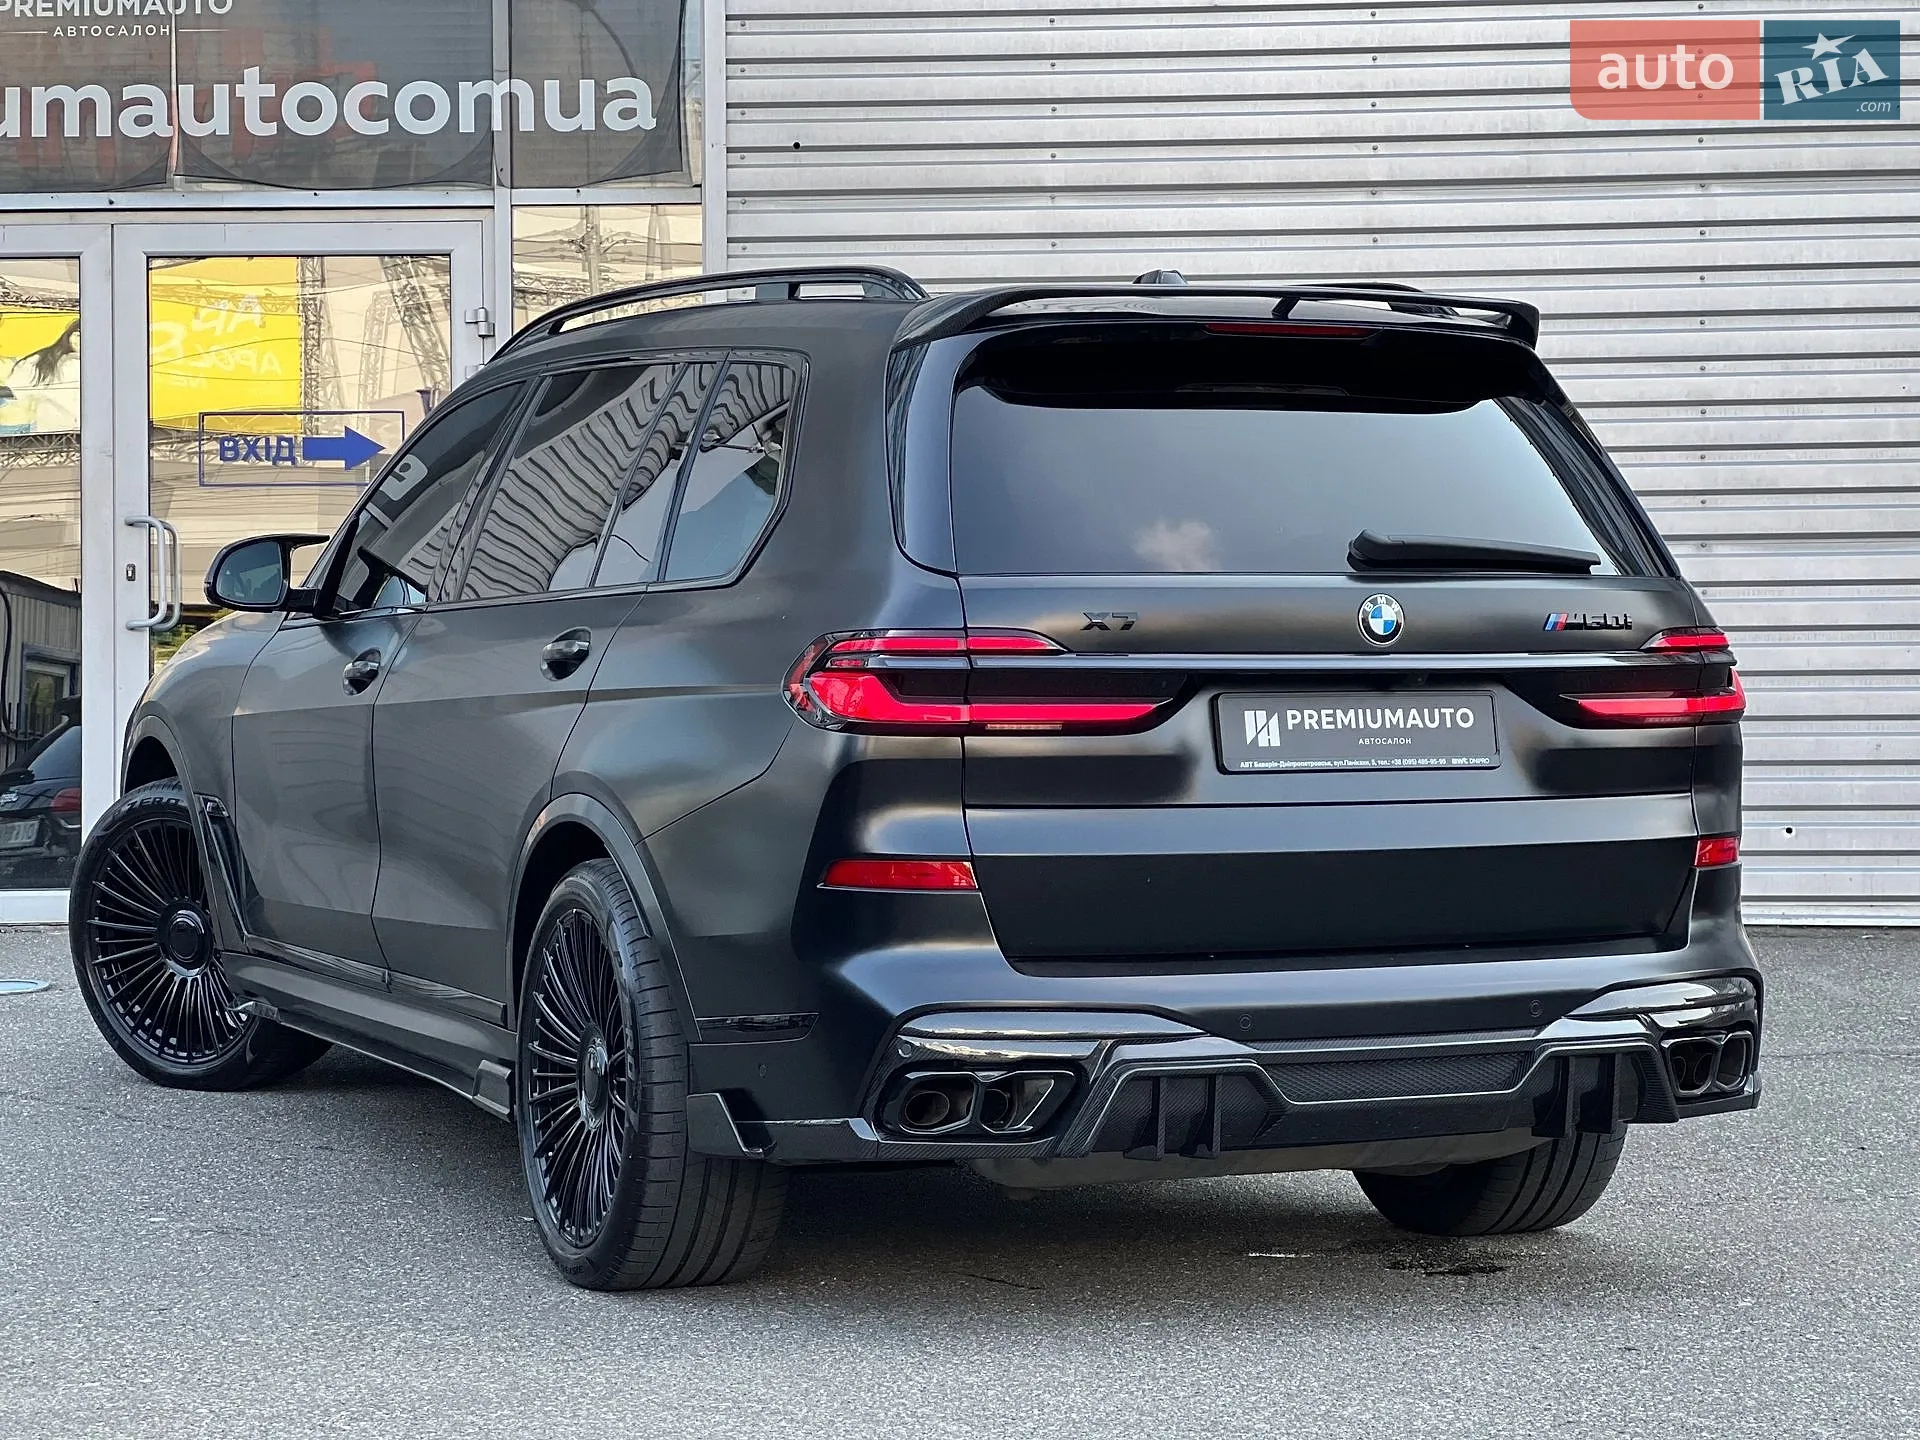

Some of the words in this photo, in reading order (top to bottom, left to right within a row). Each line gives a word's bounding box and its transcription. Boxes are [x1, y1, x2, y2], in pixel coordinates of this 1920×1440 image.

[53, 25, 170, 37] АВТОСАЛОН
[219, 435, 298, 466] ВХІД
[1364, 595, 1401, 612] BMW
[1080, 611, 1138, 631] X7
[1286, 707, 1475, 730] PREMIUMAUTO
[1358, 737, 1412, 746] АВТОСАЛОН
